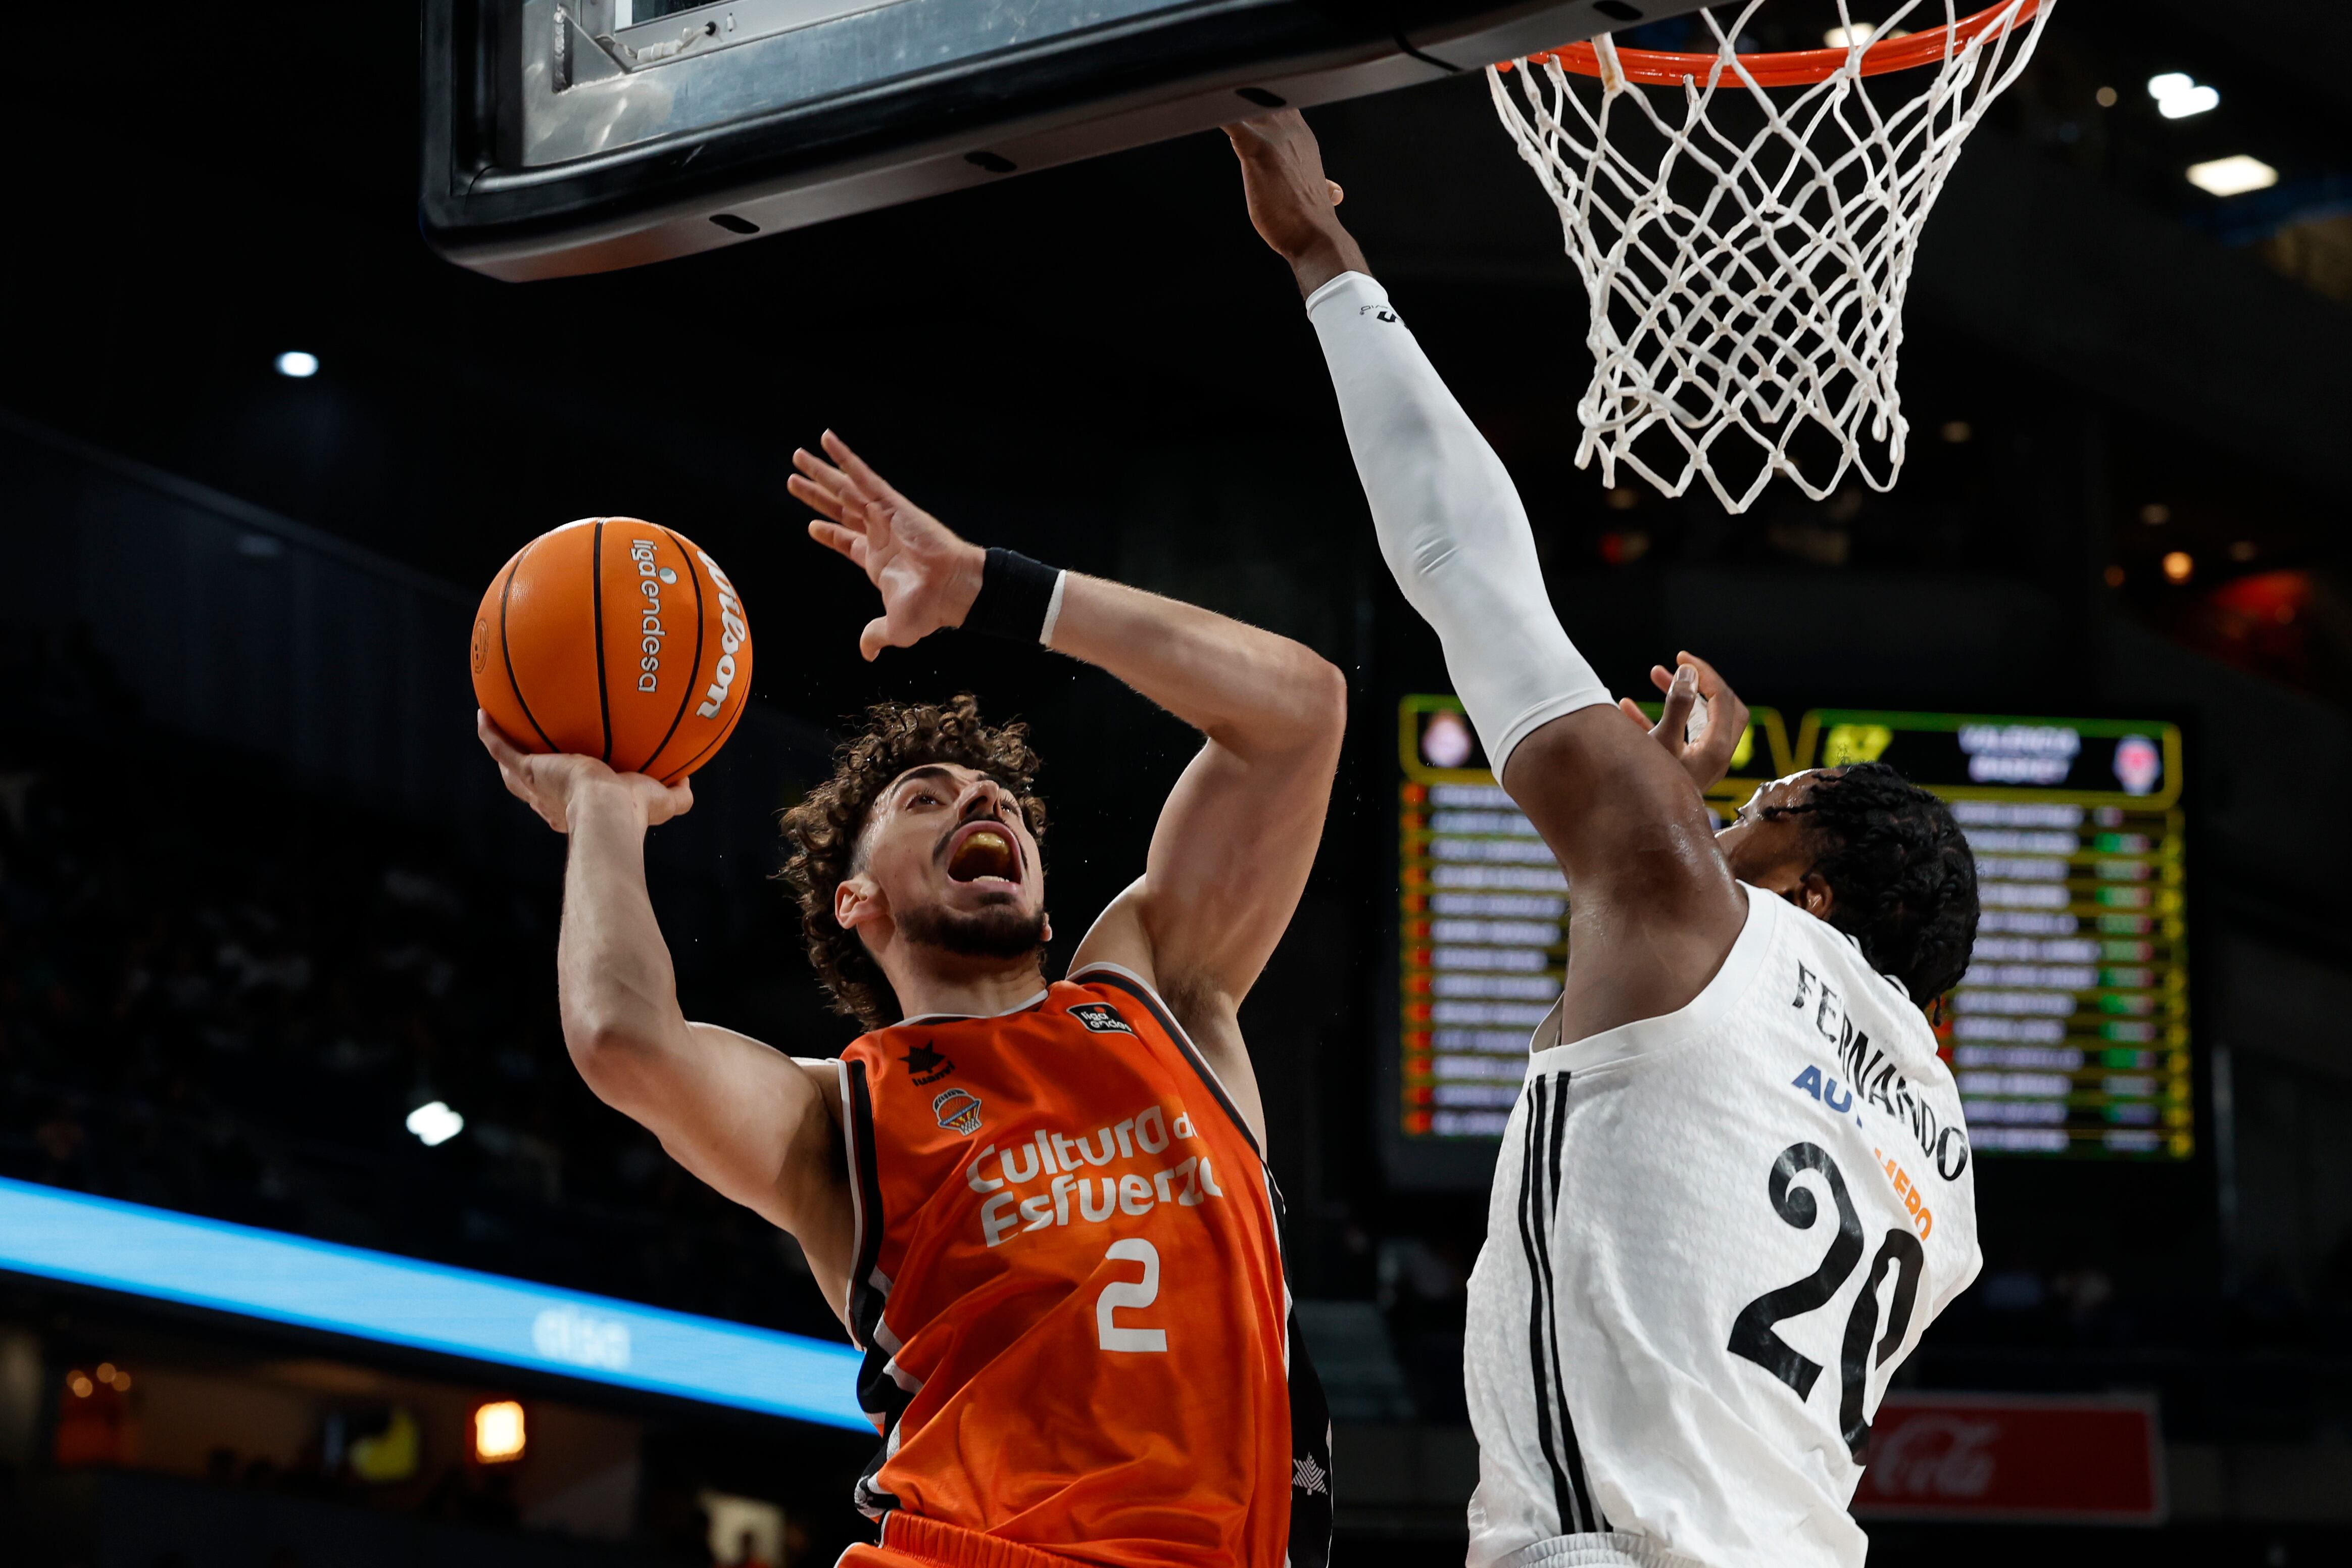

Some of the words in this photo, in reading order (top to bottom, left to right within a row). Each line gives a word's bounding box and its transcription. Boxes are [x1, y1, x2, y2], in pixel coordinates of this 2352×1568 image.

[631, 540, 658, 576] liga
[638, 579, 665, 693] endesa
[966, 1105, 1169, 1193] Cultura
[1096, 1238, 1167, 1352] 2
[1727, 1142, 1924, 1466] 20
